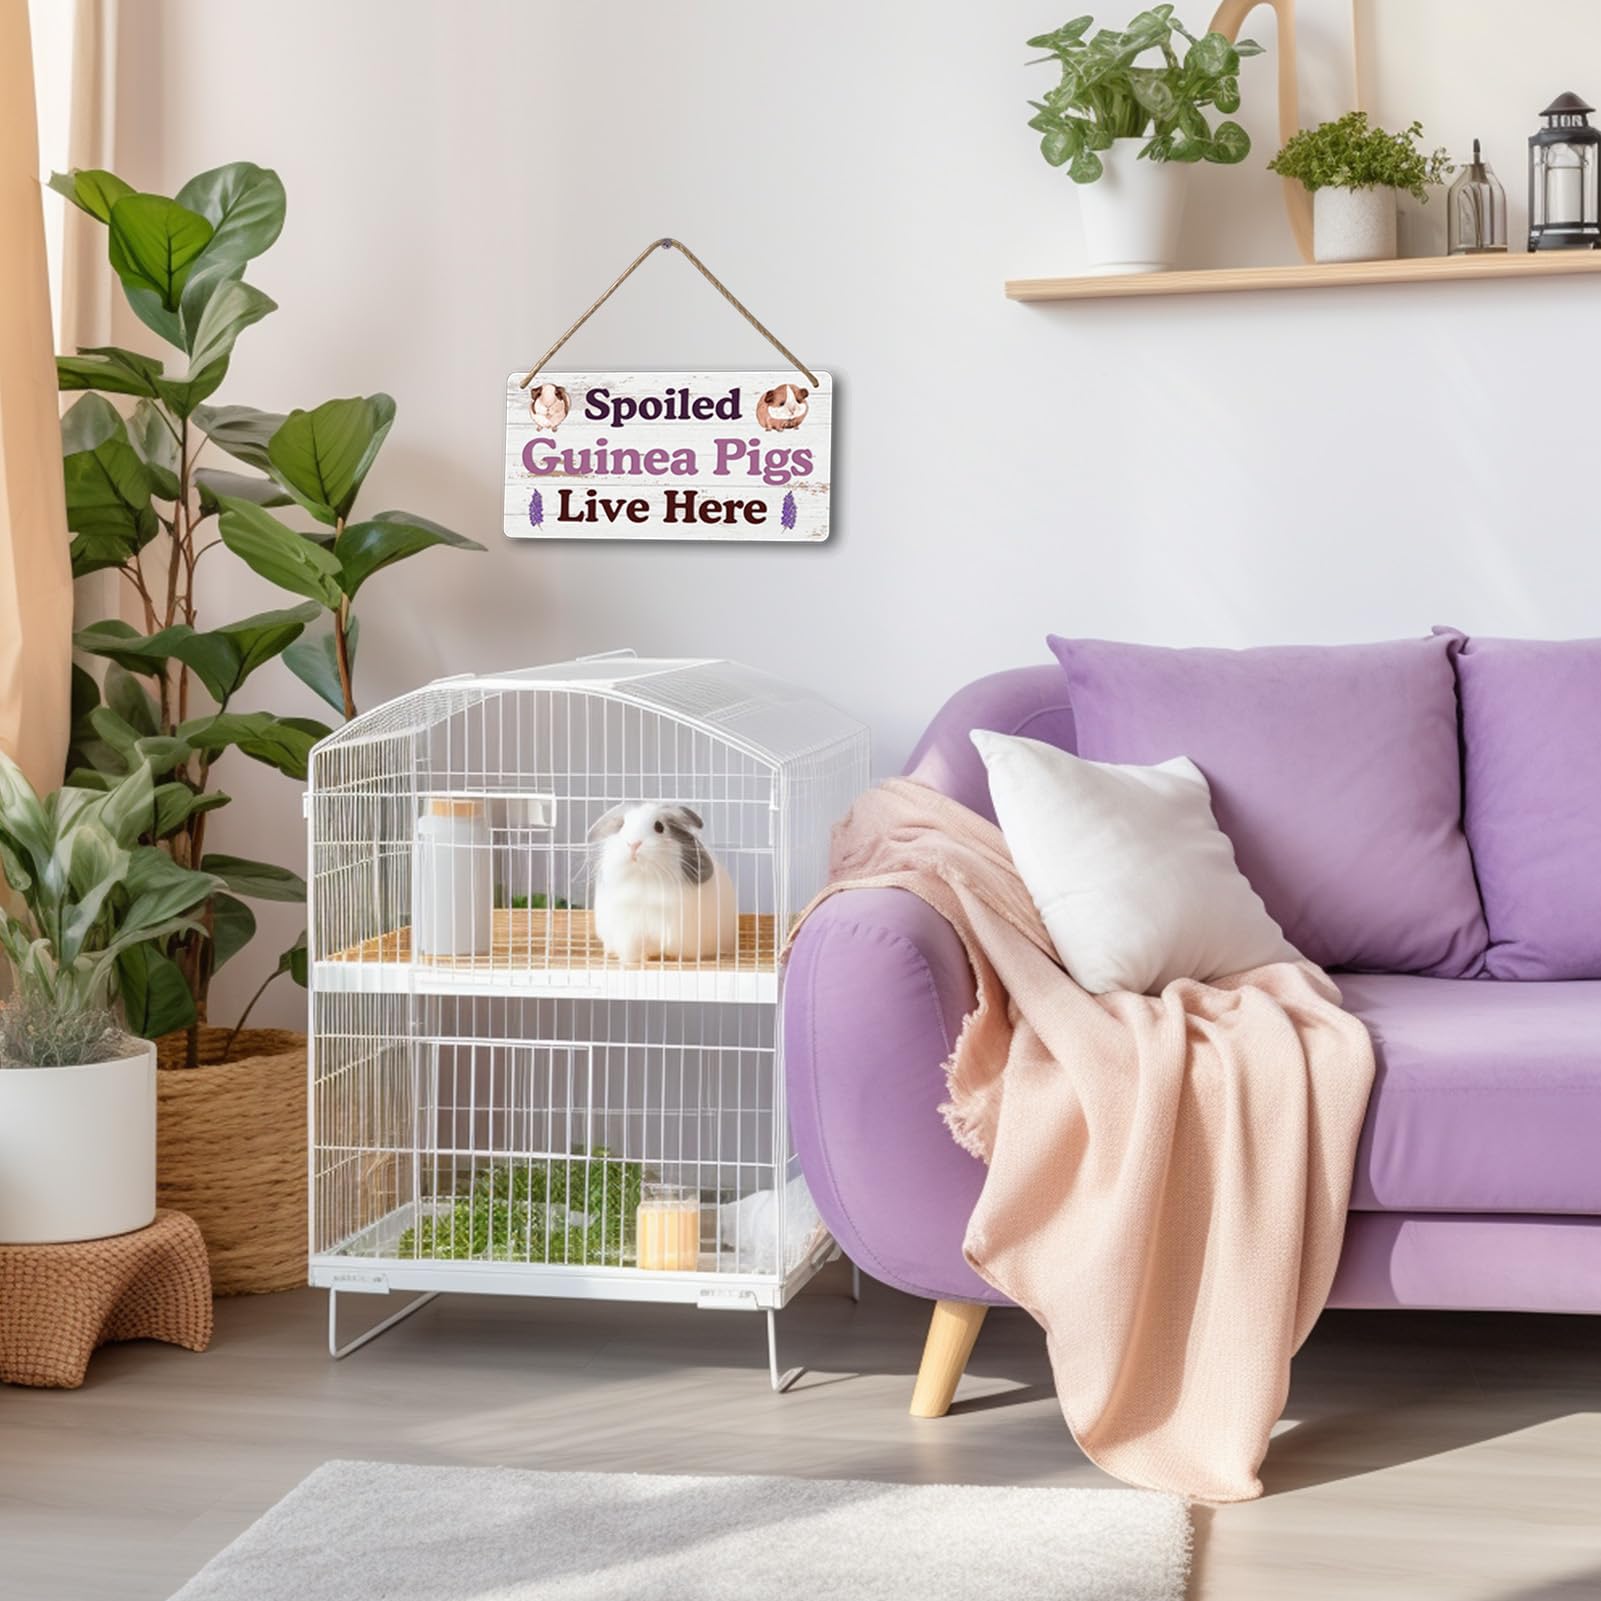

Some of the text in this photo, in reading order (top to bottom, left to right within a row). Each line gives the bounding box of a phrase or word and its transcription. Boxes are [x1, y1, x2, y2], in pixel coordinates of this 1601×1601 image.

[584, 387, 742, 427] Spoiled
[521, 437, 814, 486] Guinea Pigs
[557, 489, 768, 525] Live Here
